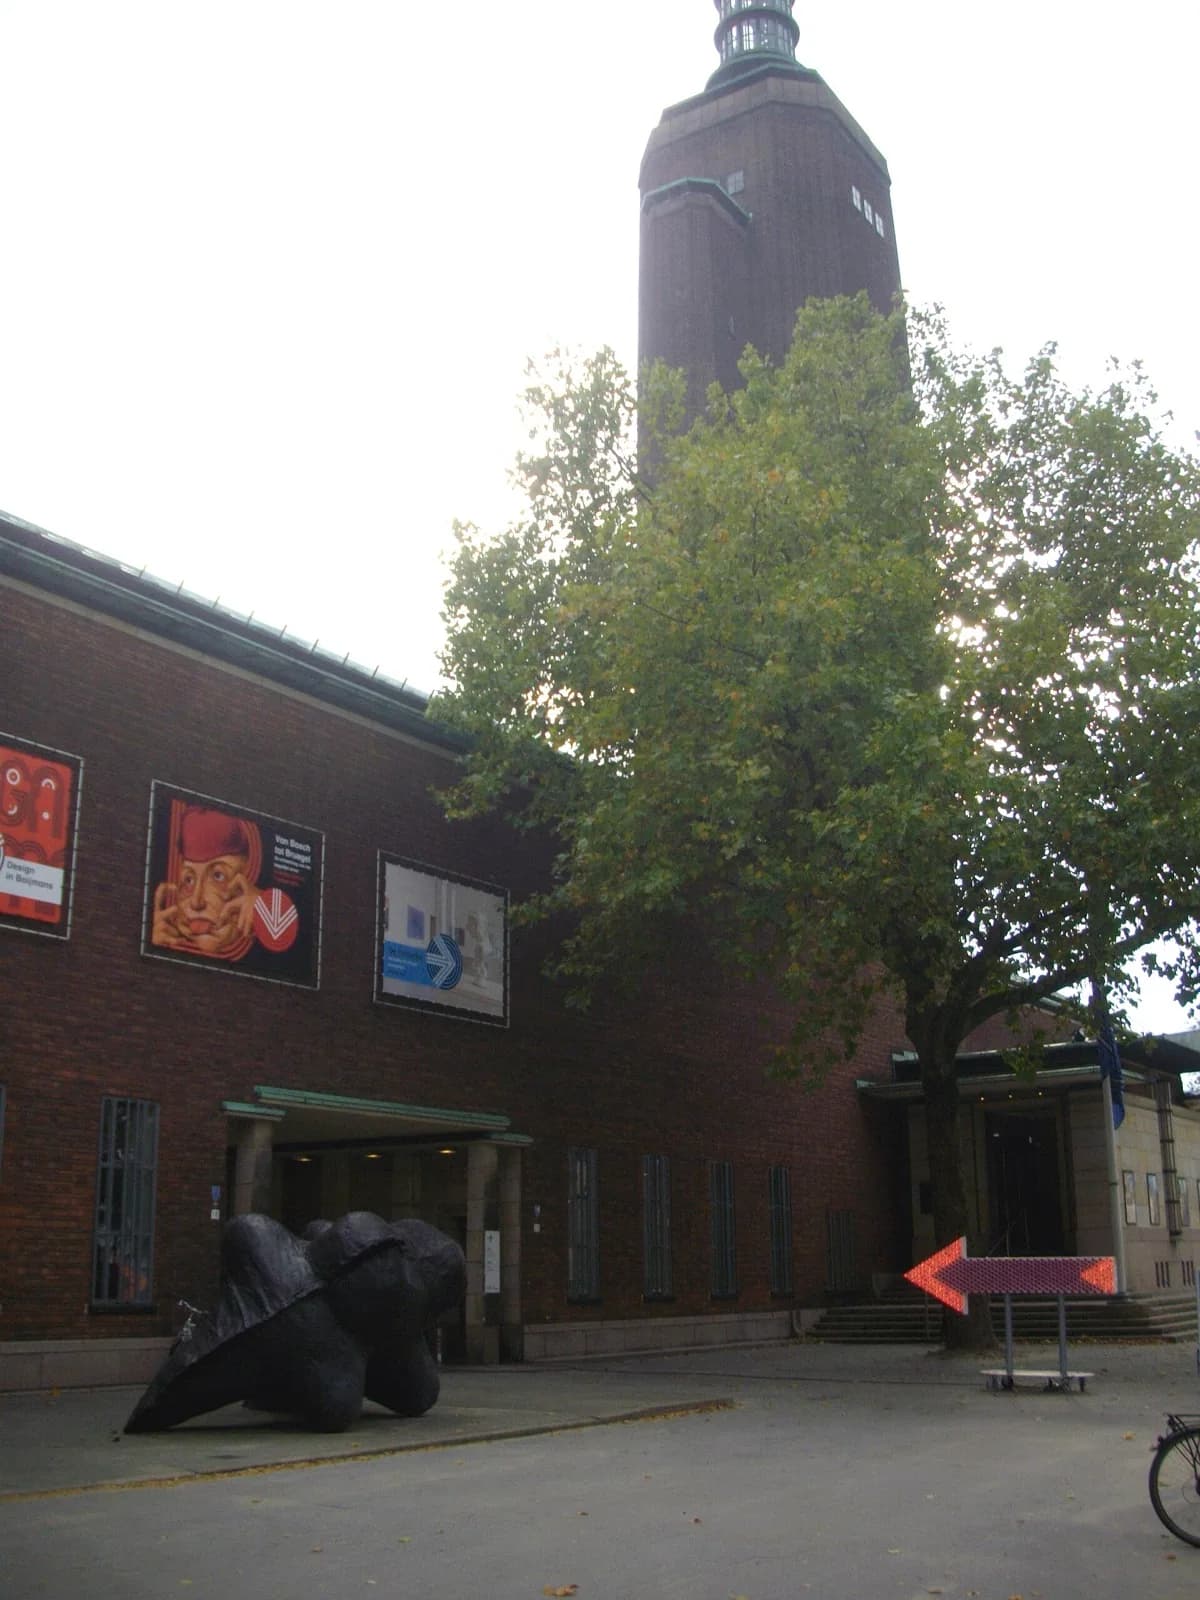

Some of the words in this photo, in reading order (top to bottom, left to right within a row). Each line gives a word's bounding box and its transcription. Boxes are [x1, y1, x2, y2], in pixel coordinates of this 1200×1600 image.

[275, 834, 289, 846] Van
[290, 839, 311, 852] Bosch
[7, 861, 35, 875] Design
[5, 872, 14, 881] in
